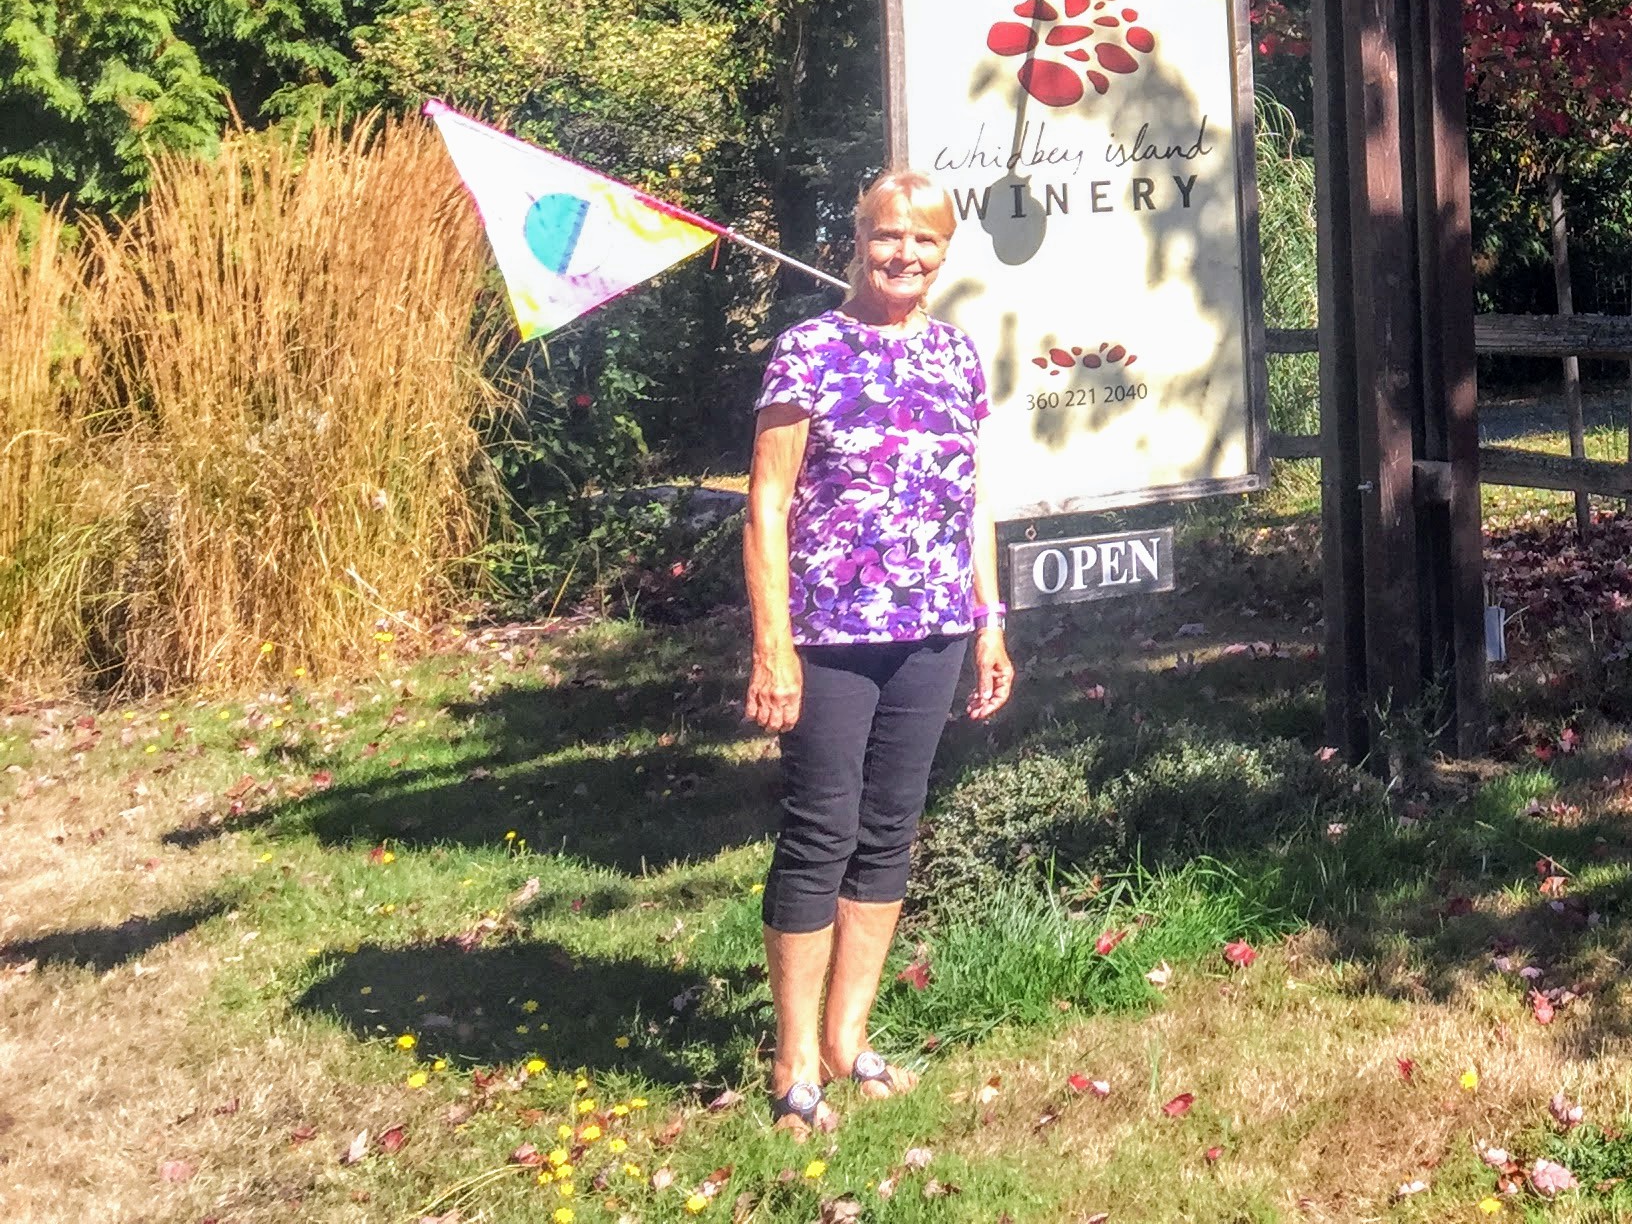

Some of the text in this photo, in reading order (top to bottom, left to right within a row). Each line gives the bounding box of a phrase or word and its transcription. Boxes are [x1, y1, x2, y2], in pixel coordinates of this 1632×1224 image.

[934, 114, 1213, 175] whidbey island
[953, 174, 1199, 221] WINERY
[1026, 382, 1148, 411] 360 221 2040
[1032, 537, 1161, 594] OPEN
